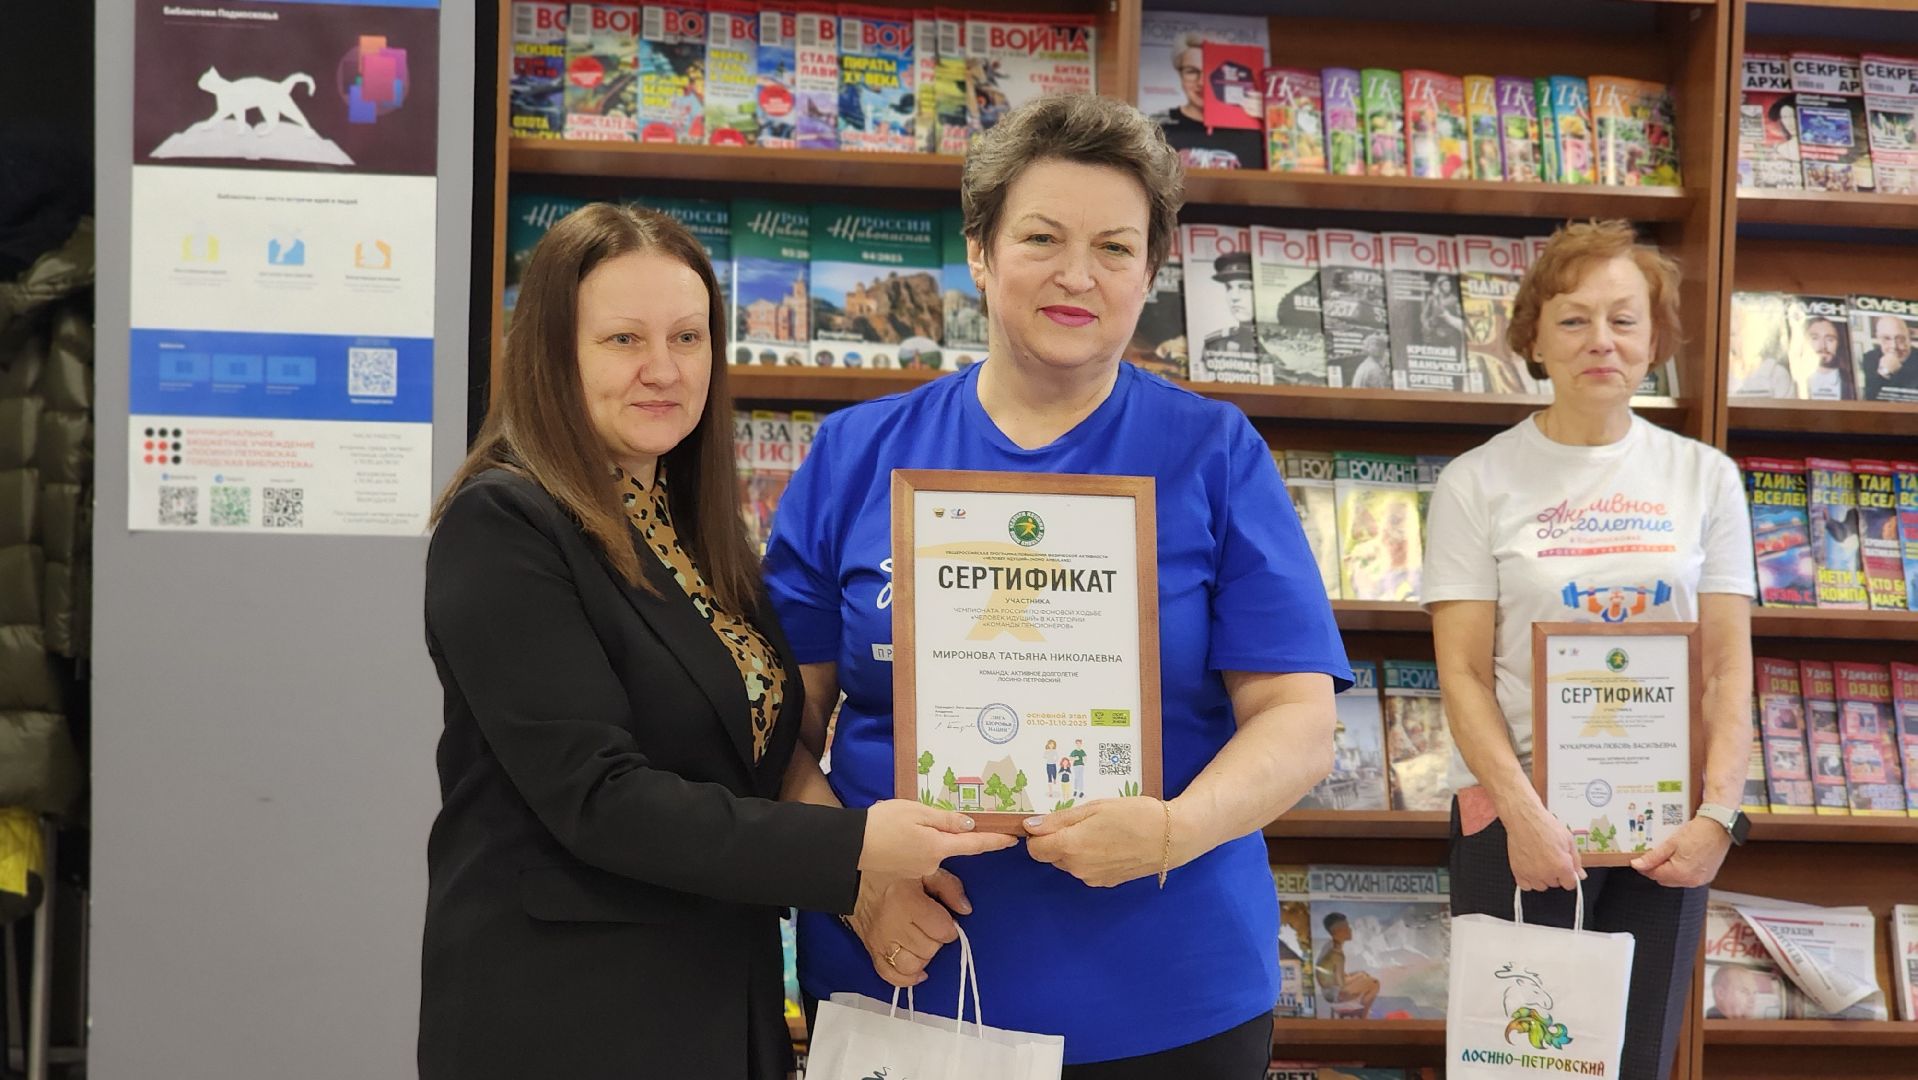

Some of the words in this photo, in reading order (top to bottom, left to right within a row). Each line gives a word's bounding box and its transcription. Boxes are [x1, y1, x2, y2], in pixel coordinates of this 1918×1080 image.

[990, 25, 1090, 55] ВОЙНА
[861, 216, 932, 232] РОССИЯ
[938, 564, 1117, 593] СЕРТИФИКАТ
[1005, 597, 1051, 605] УЧАСТНИКА
[932, 650, 996, 661] МИРОНОВА
[999, 651, 1047, 662] ТАТЬЯНА
[1050, 652, 1123, 663] НИКОЛАЕВНА
[1561, 686, 1676, 704] СЕРТИФИКАТ
